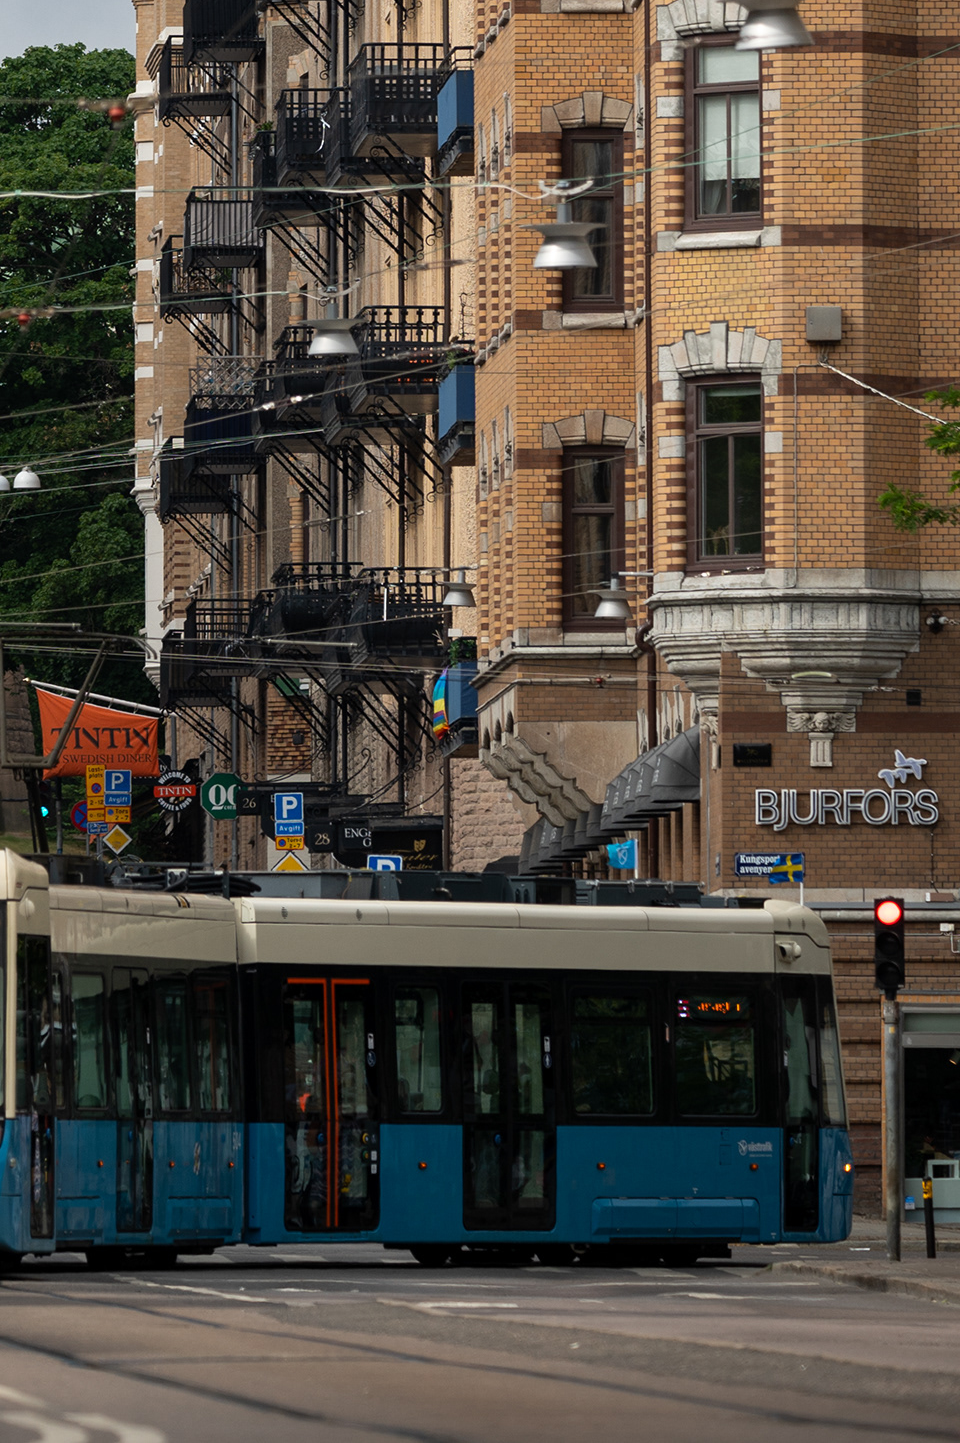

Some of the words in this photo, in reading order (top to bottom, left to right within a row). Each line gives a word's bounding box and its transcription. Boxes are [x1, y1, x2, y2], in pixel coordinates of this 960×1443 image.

[62, 754, 114, 765] SWEDISH
[117, 753, 153, 764] DINER
[111, 773, 124, 790] P
[157, 771, 185, 785] WELCOME
[158, 786, 193, 796] TINTIN
[242, 797, 257, 809] 26
[282, 796, 298, 819] P
[755, 788, 939, 832] BJURFORS
[279, 825, 301, 833] Avgift
[314, 833, 331, 846] 28
